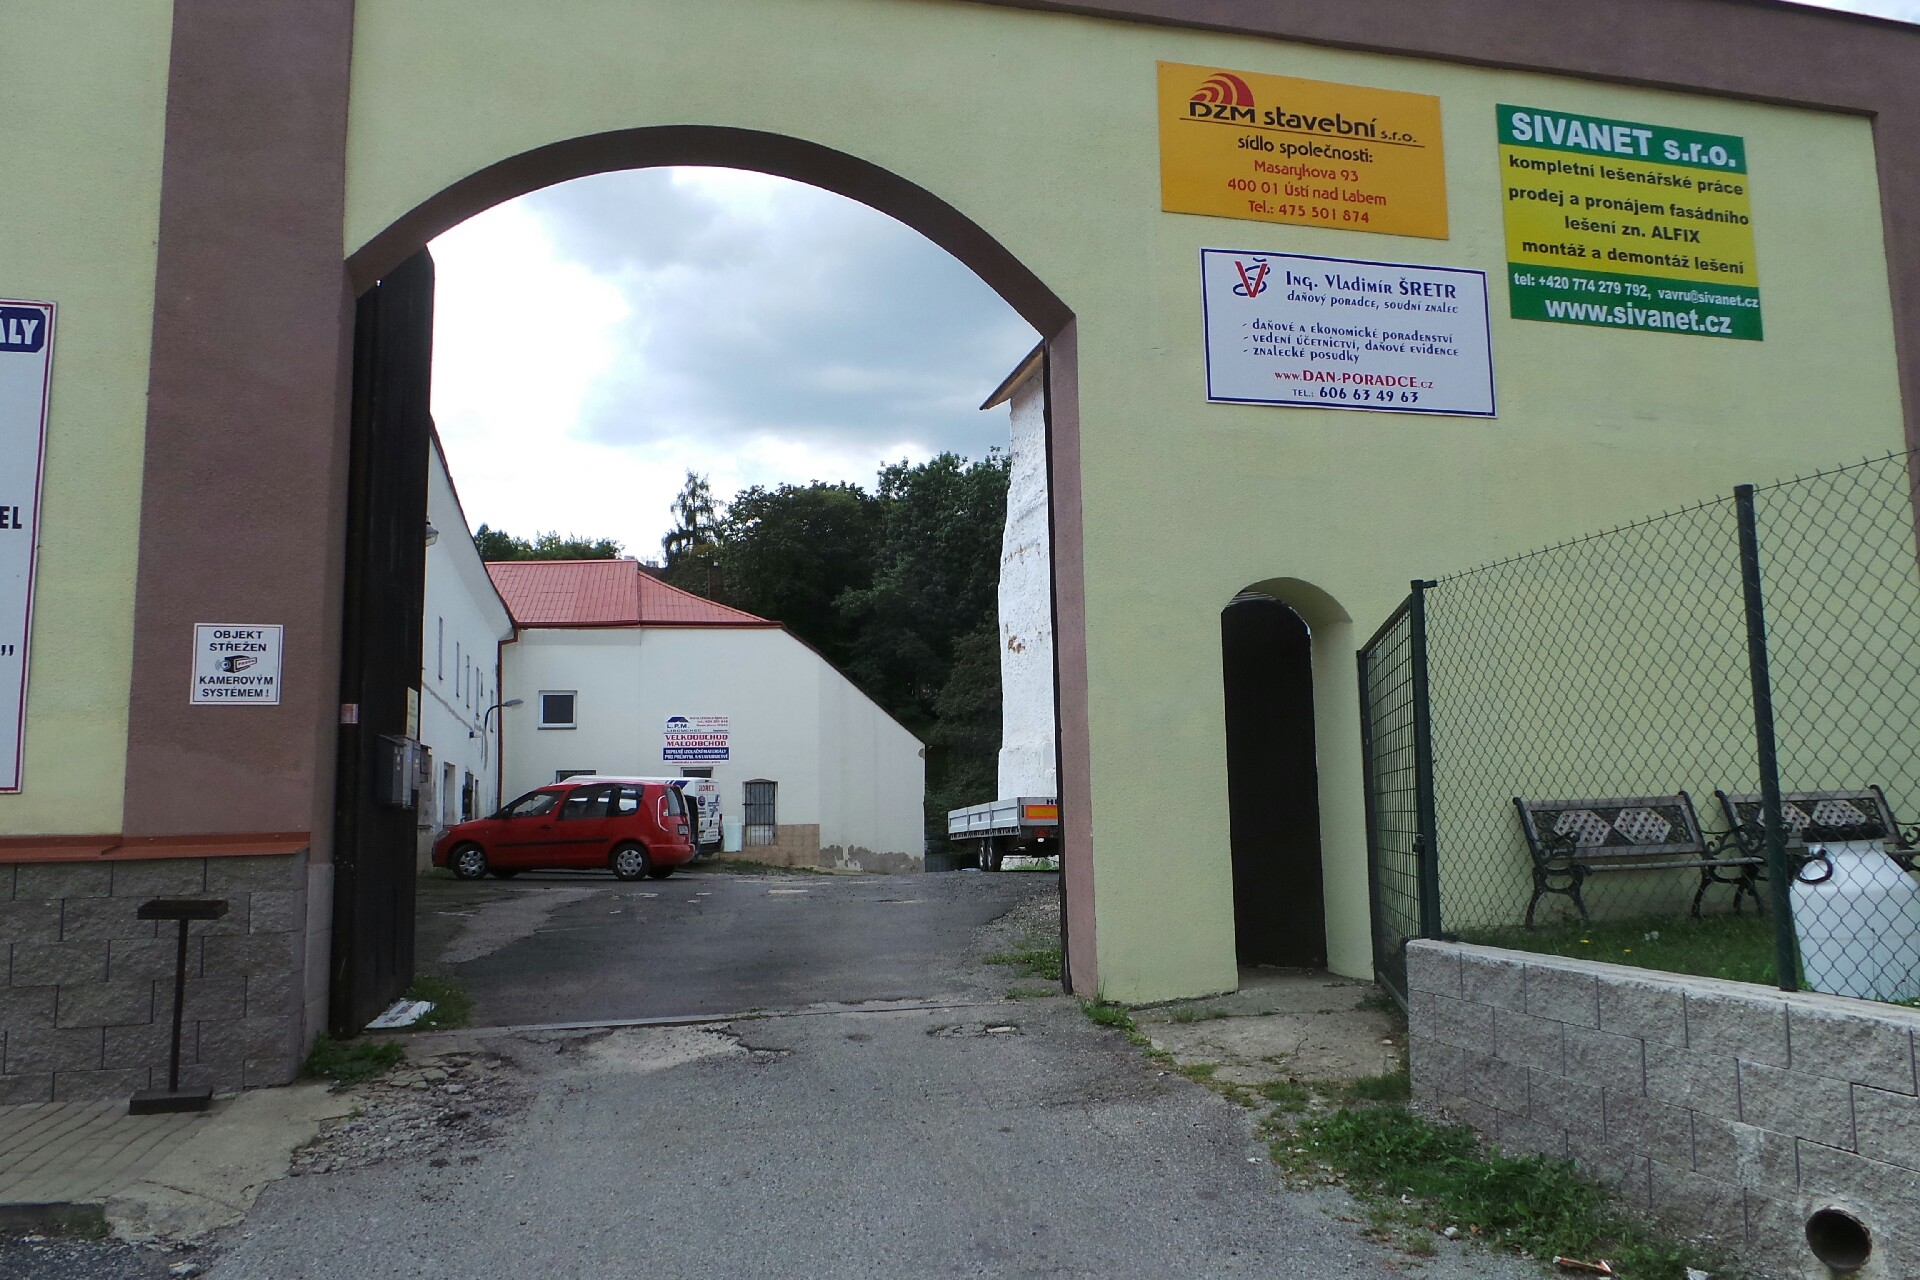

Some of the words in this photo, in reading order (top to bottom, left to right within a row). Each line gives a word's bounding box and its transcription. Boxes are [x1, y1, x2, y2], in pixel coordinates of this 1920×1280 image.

[1189, 101, 1255, 123] DZM
[1264, 107, 1376, 137] stavební
[1381, 130, 1416, 143] s.r.o.
[1238, 135, 1274, 152] sídlo
[1511, 112, 1653, 156] SIVANET
[1663, 139, 1736, 168] s.r.o.
[1254, 159, 1336, 180] Masarykova
[1341, 170, 1359, 182] 93
[1509, 154, 1595, 178] kompletní
[1600, 165, 1693, 189] lešenářské
[1697, 179, 1744, 196] práce
[1227, 178, 1256, 192] 400
[1261, 181, 1278, 195] 01
[1285, 181, 1309, 198] Ústí
[1312, 187, 1338, 201] nad
[1342, 190, 1387, 206] Labem
[1248, 200, 1274, 214] Tel.:
[1278, 204, 1305, 217] 475
[1311, 207, 1336, 220] 501
[1343, 210, 1369, 224] 874
[1508, 186, 1564, 207] prodej
[1570, 194, 1579, 205] a
[1585, 195, 1665, 215] pronájem
[1669, 203, 1749, 226] fasádního
[1565, 216, 1616, 235] lešení
[1622, 226, 1646, 238] zn.
[1651, 226, 1701, 244] ALFIX
[1522, 239, 1586, 258] montáž
[1592, 249, 1601, 259] a
[1607, 248, 1689, 269] demontáž
[1694, 256, 1744, 274] lešení
[1399, 277, 1456, 299] ŠRETR
[1514, 272, 1536, 286] tel:
[1538, 275, 1569, 290] +420
[1572, 278, 1595, 292] 774
[1598, 280, 1621, 295] 279
[1624, 282, 1651, 299] 792,
[1657, 288, 1759, 308] vavru@sivanet.cz
[1544, 299, 1732, 333] www.sivanet.cz
[1319, 387, 1347, 400] 606
[1352, 388, 1371, 401] 63
[1376, 390, 1395, 402] 49
[1400, 391, 1419, 403] 63
[209, 641, 267, 652] STŘEŽEN
[213, 630, 263, 639] OBJEKT
[199, 674, 273, 685] KAMEROVÝM
[202, 686, 263, 697] SYSTÉMEM
